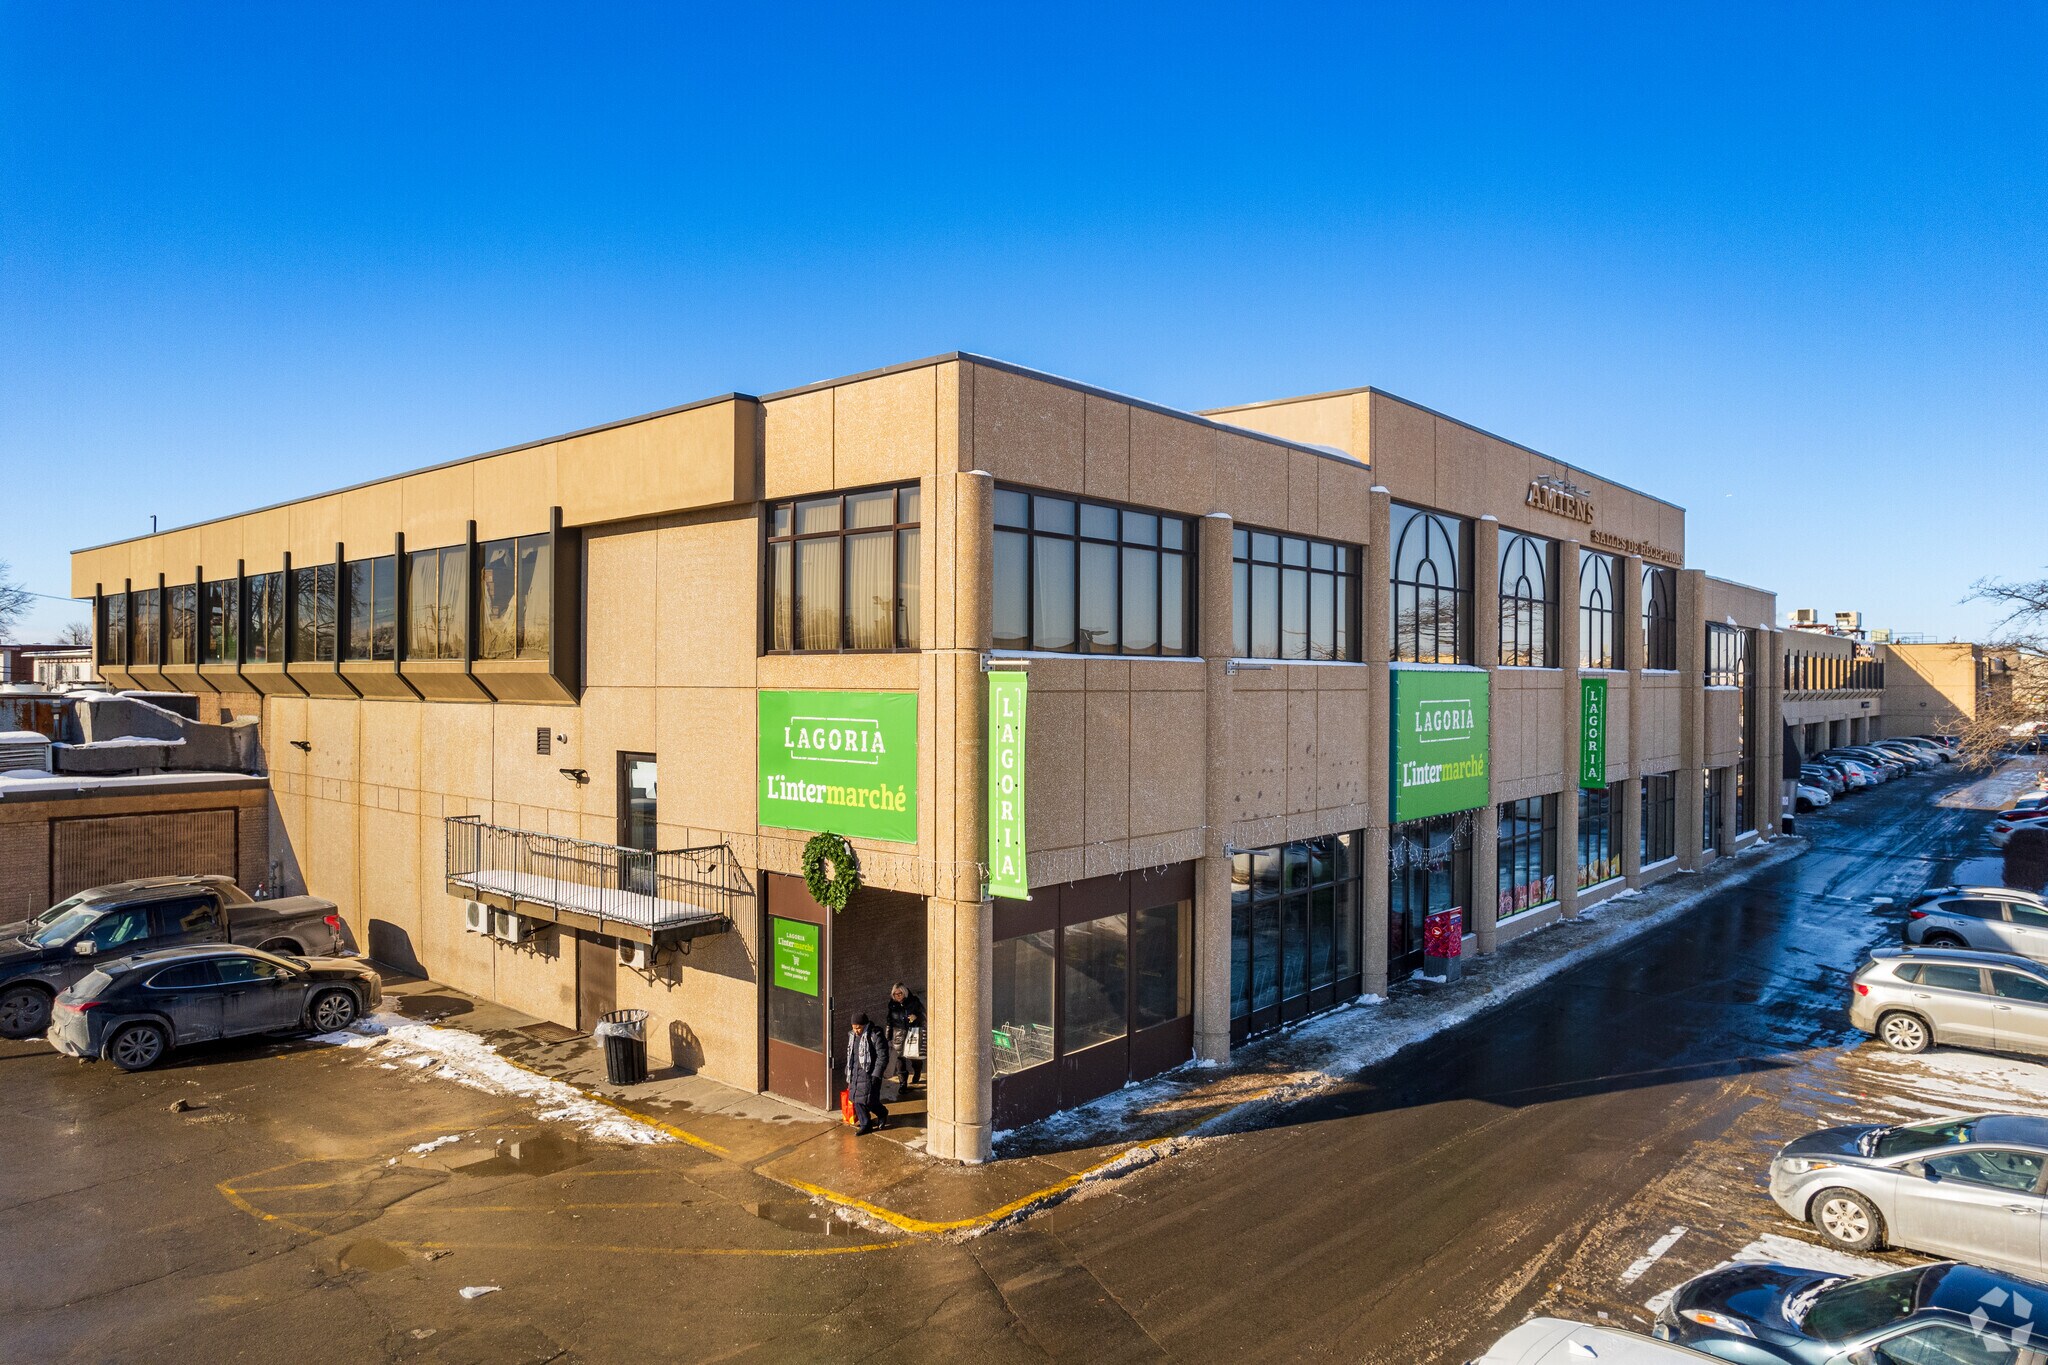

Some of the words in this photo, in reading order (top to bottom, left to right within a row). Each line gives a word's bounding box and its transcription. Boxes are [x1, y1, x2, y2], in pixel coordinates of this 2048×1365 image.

[1527, 482, 1594, 524] AMIENS
[1591, 530, 1627, 551] SALLES
[1628, 539, 1639, 553] DE
[1415, 709, 1474, 732] LAGORIA
[1588, 690, 1598, 778] LAGORIA
[784, 726, 886, 754] LAGORIA
[1001, 697, 1015, 876] LAGORIA
[1403, 753, 1484, 787] L'intermarché
[767, 774, 907, 812] L'intermarché
[786, 932, 805, 941] LAGORIA
